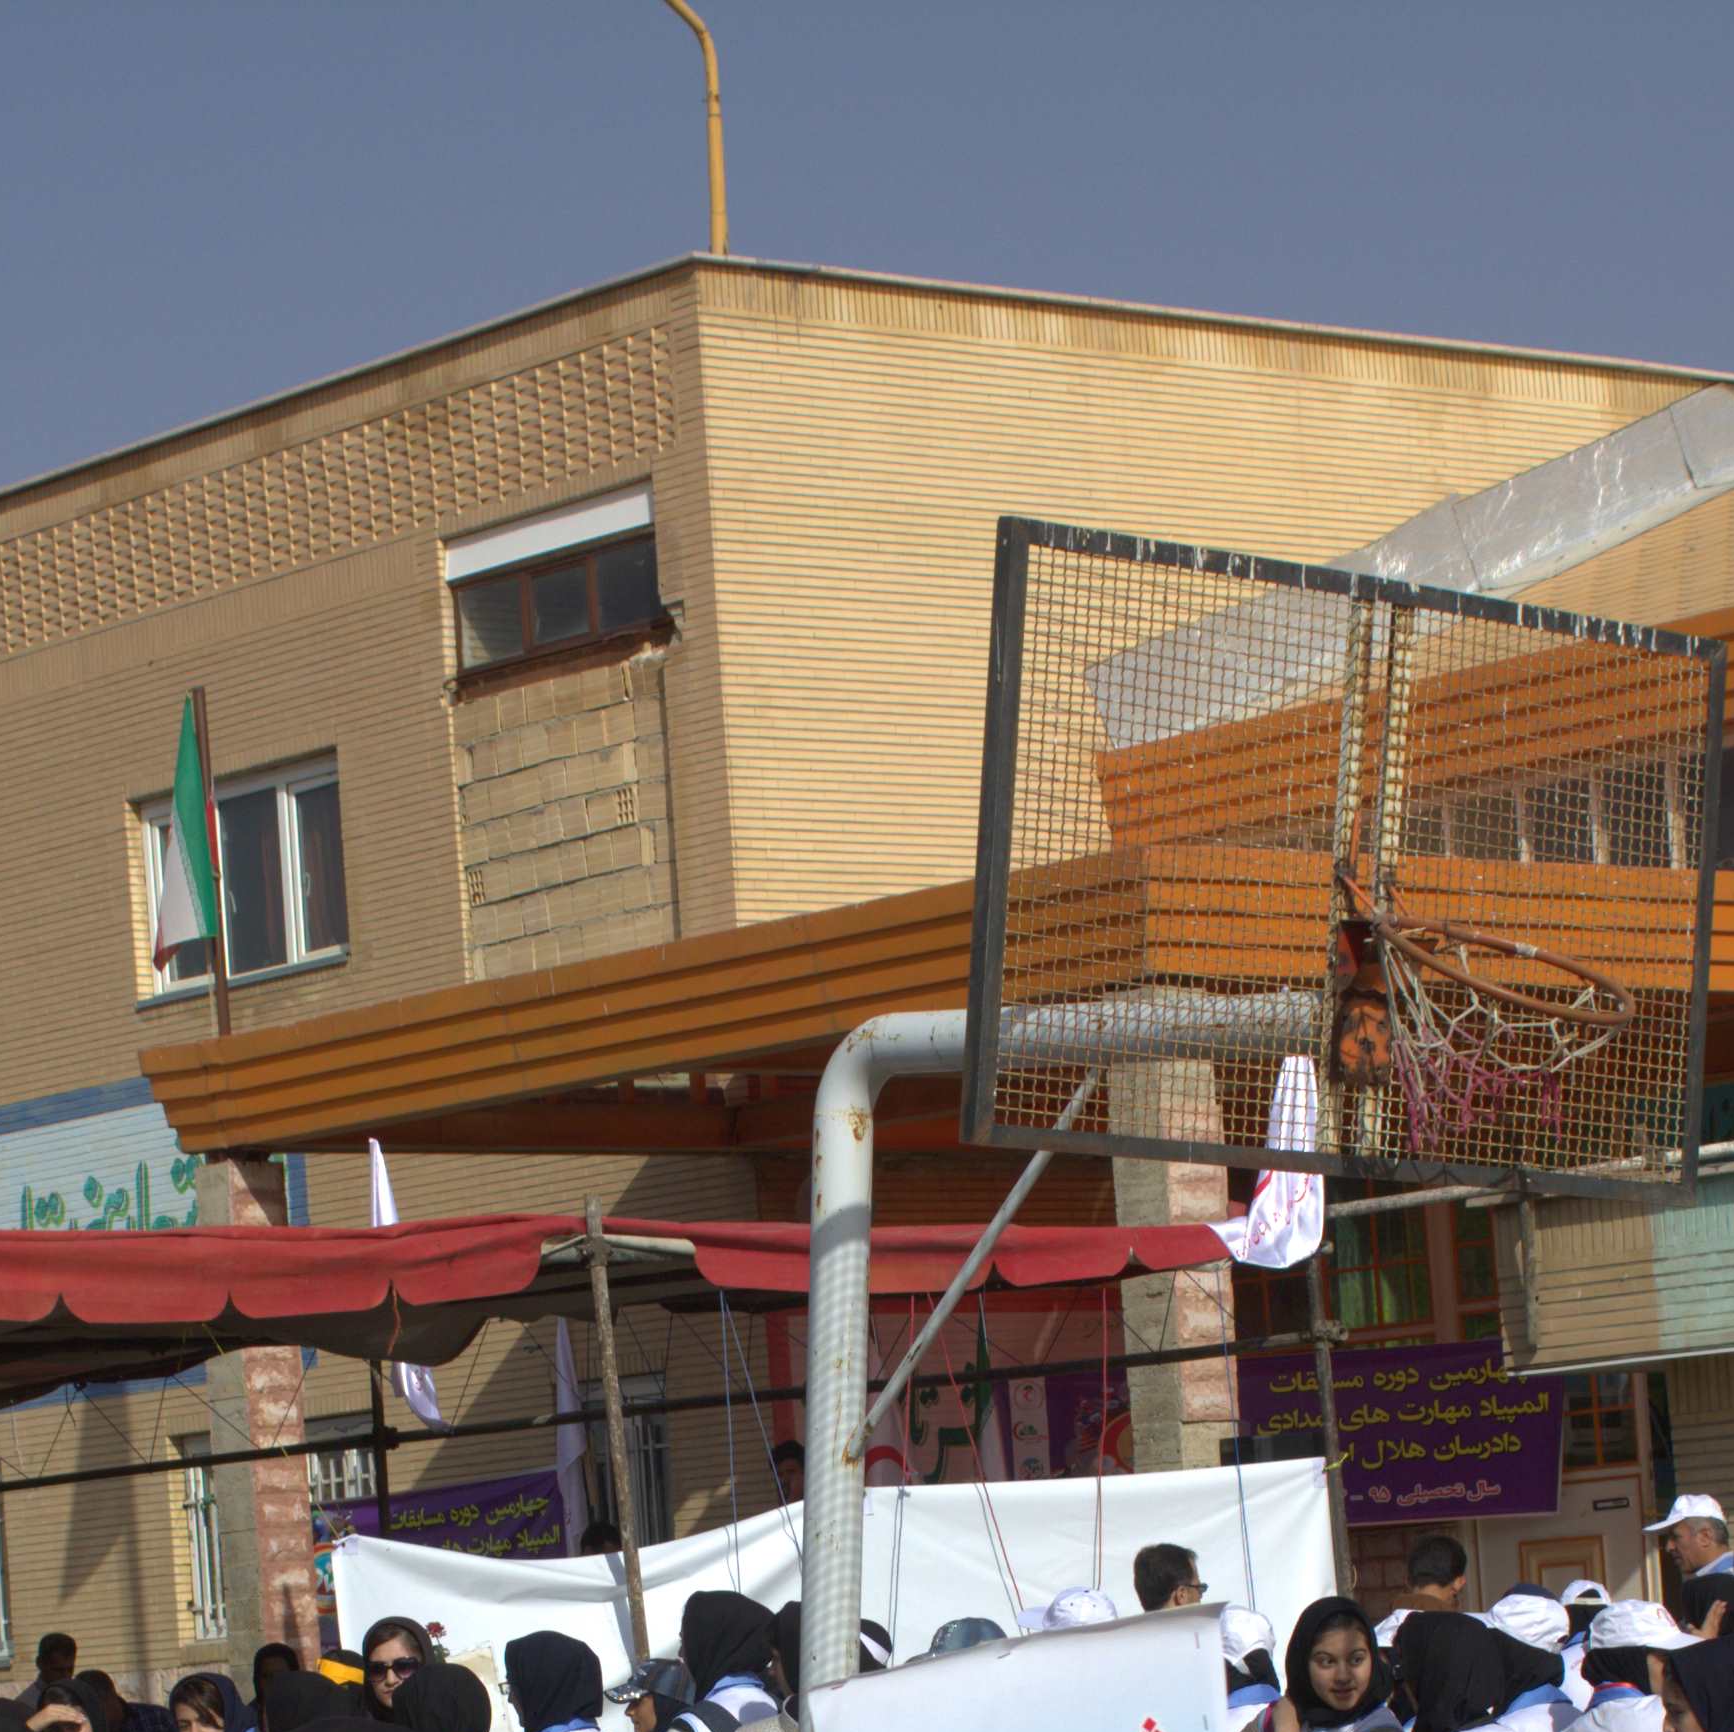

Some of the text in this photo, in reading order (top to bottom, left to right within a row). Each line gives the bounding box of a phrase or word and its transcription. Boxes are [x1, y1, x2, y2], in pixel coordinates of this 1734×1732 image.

[1373, 1366, 1420, 1394] دوره
[1429, 1356, 1529, 1392] هارمین
[1256, 1391, 1550, 1438] المپیاد مهارت های مدادی
[1361, 1438, 1427, 1471] هلال
[1433, 1431, 1523, 1464] دادرسان
[1396, 1482, 1466, 1508] تحصیلی
[1467, 1479, 1502, 1504] سال
[449, 1503, 480, 1527] دوره
